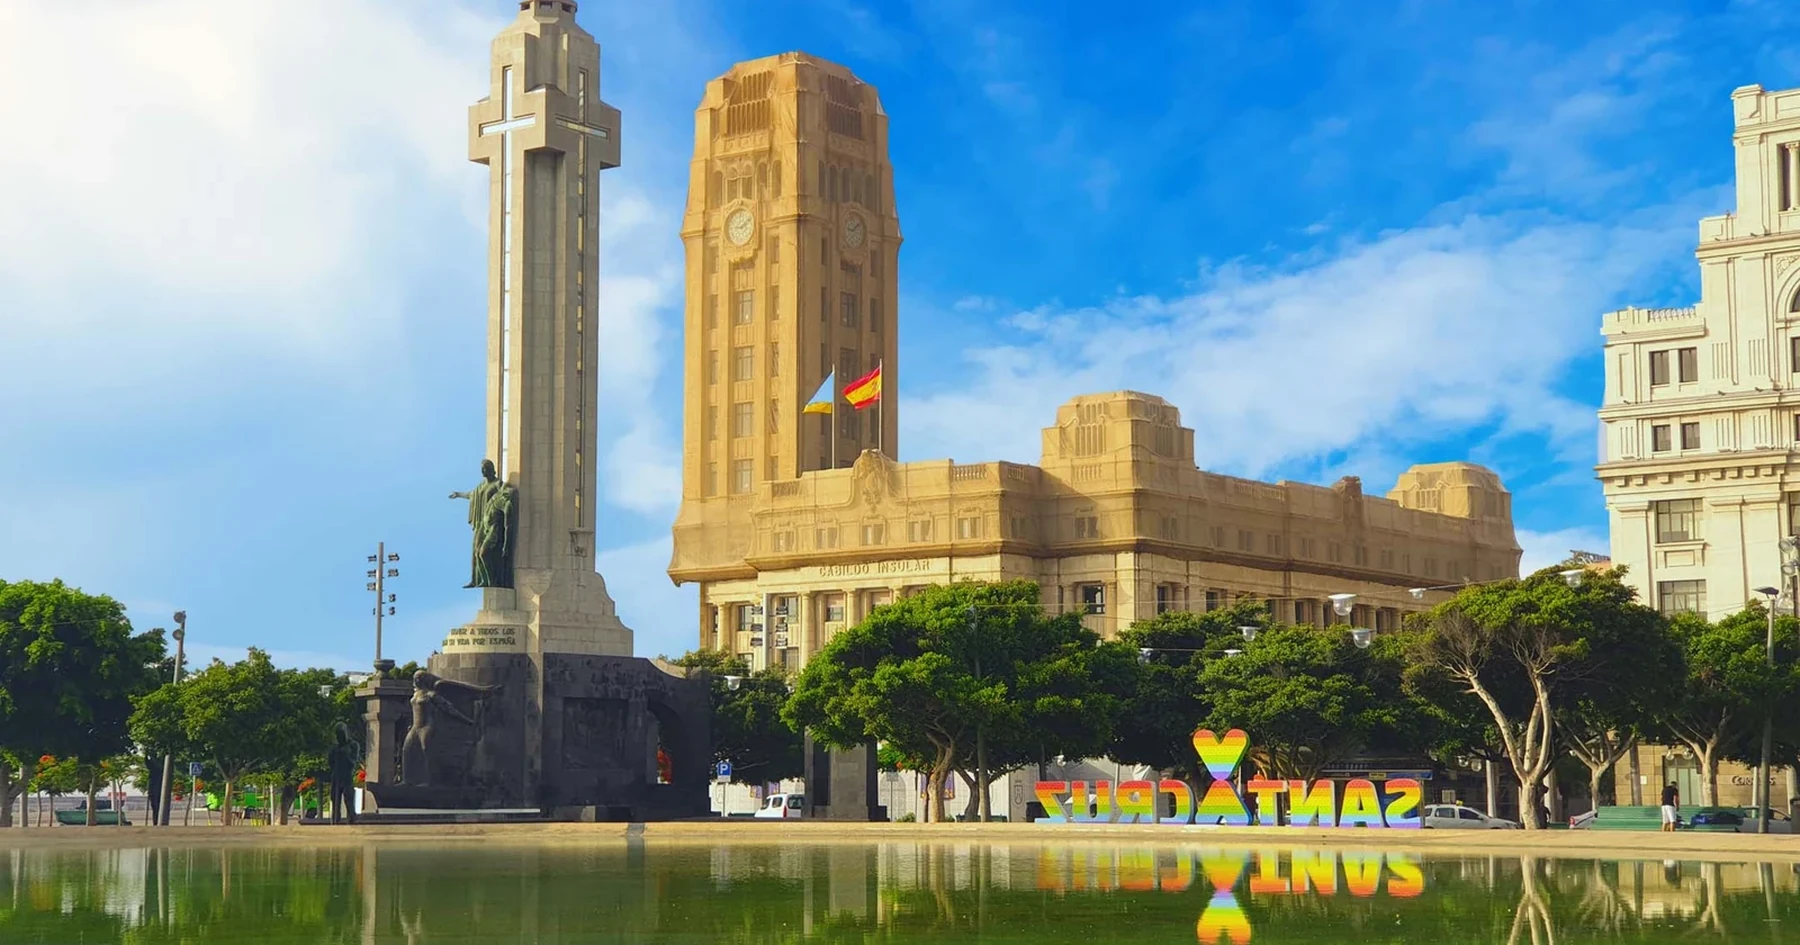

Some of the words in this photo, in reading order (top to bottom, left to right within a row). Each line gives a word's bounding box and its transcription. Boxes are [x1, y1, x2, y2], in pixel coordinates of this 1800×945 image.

[819, 564, 870, 577] CABILDO
[877, 558, 930, 574] INSULAR
[502, 627, 516, 635] LOS
[489, 636, 516, 646] ESPAÑA
[720, 764, 729, 775] P
